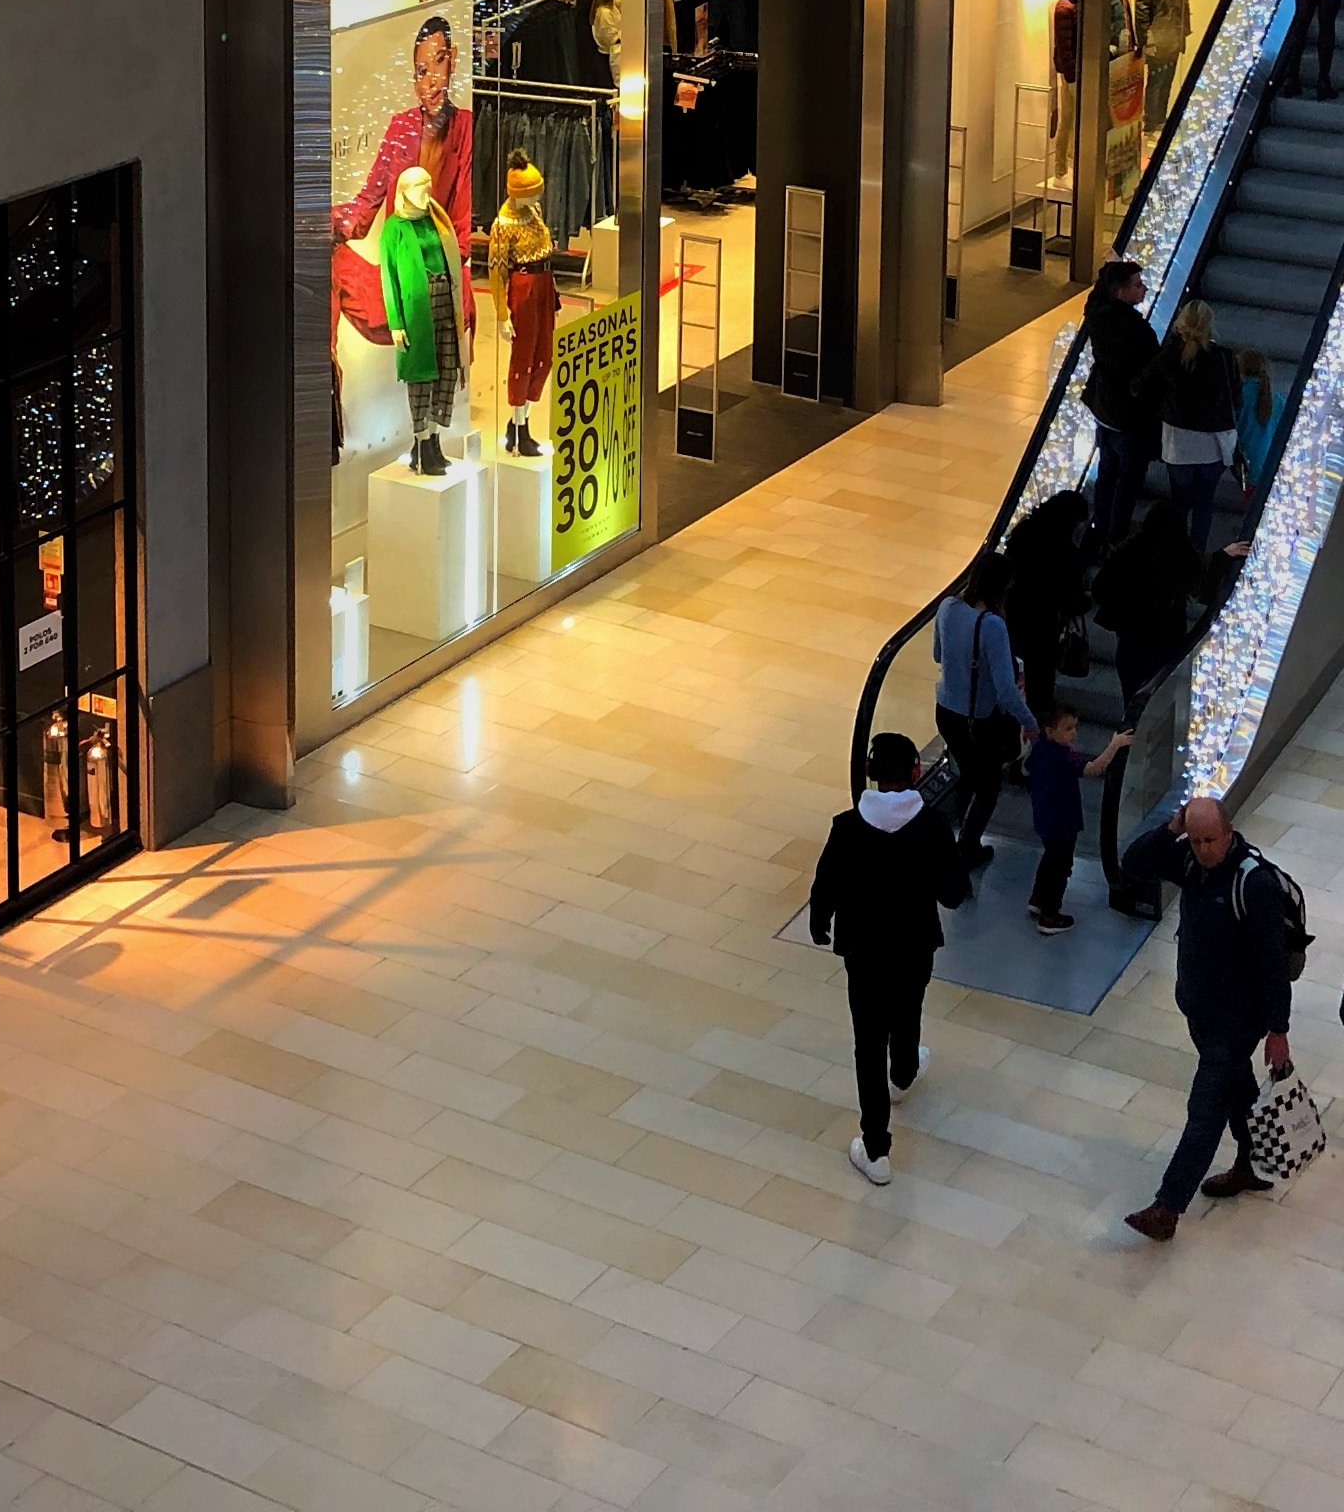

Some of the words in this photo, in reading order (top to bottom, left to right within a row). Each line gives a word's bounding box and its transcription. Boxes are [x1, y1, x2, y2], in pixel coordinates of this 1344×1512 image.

[557, 305, 638, 358] SEASONAL
[557, 328, 637, 389] OFFERS
[556, 378, 600, 438] 30
[623, 357, 637, 405] OFF
[556, 426, 599, 486] 30
[622, 403, 636, 452] OFF
[555, 474, 599, 534] 30
[622, 450, 636, 499] OFF
[29, 627, 52, 643] POLOS
